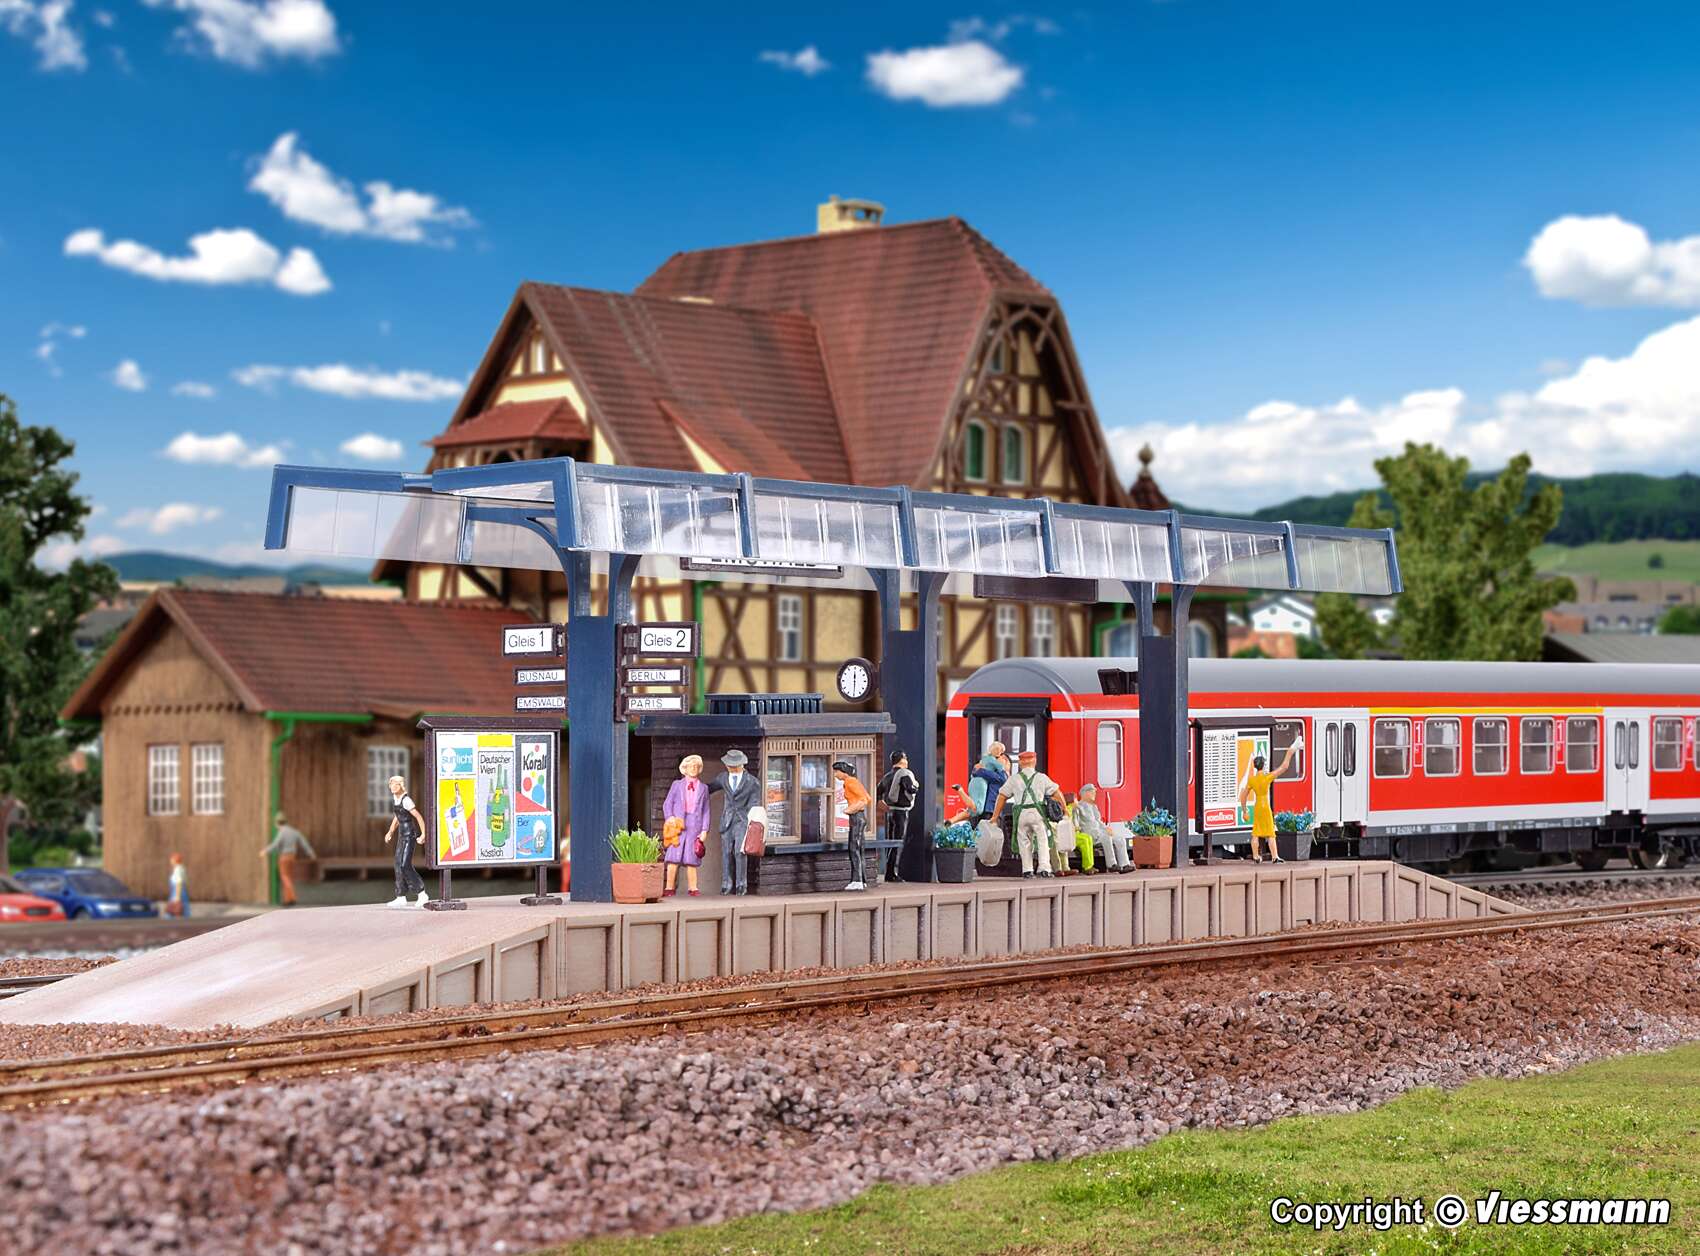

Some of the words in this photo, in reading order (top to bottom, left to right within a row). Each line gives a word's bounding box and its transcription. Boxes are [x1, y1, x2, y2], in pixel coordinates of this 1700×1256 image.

[508, 634, 536, 648] Gleis
[538, 630, 545, 647] 1
[643, 632, 673, 647] Gleis
[676, 630, 687, 648] 2
[630, 671, 667, 681] BERLIN
[518, 698, 564, 708] EMSWALD
[630, 699, 664, 708] PARIS
[480, 754, 511, 764] Deutscher
[523, 753, 547, 770] Korall
[480, 765, 496, 773] Wein
